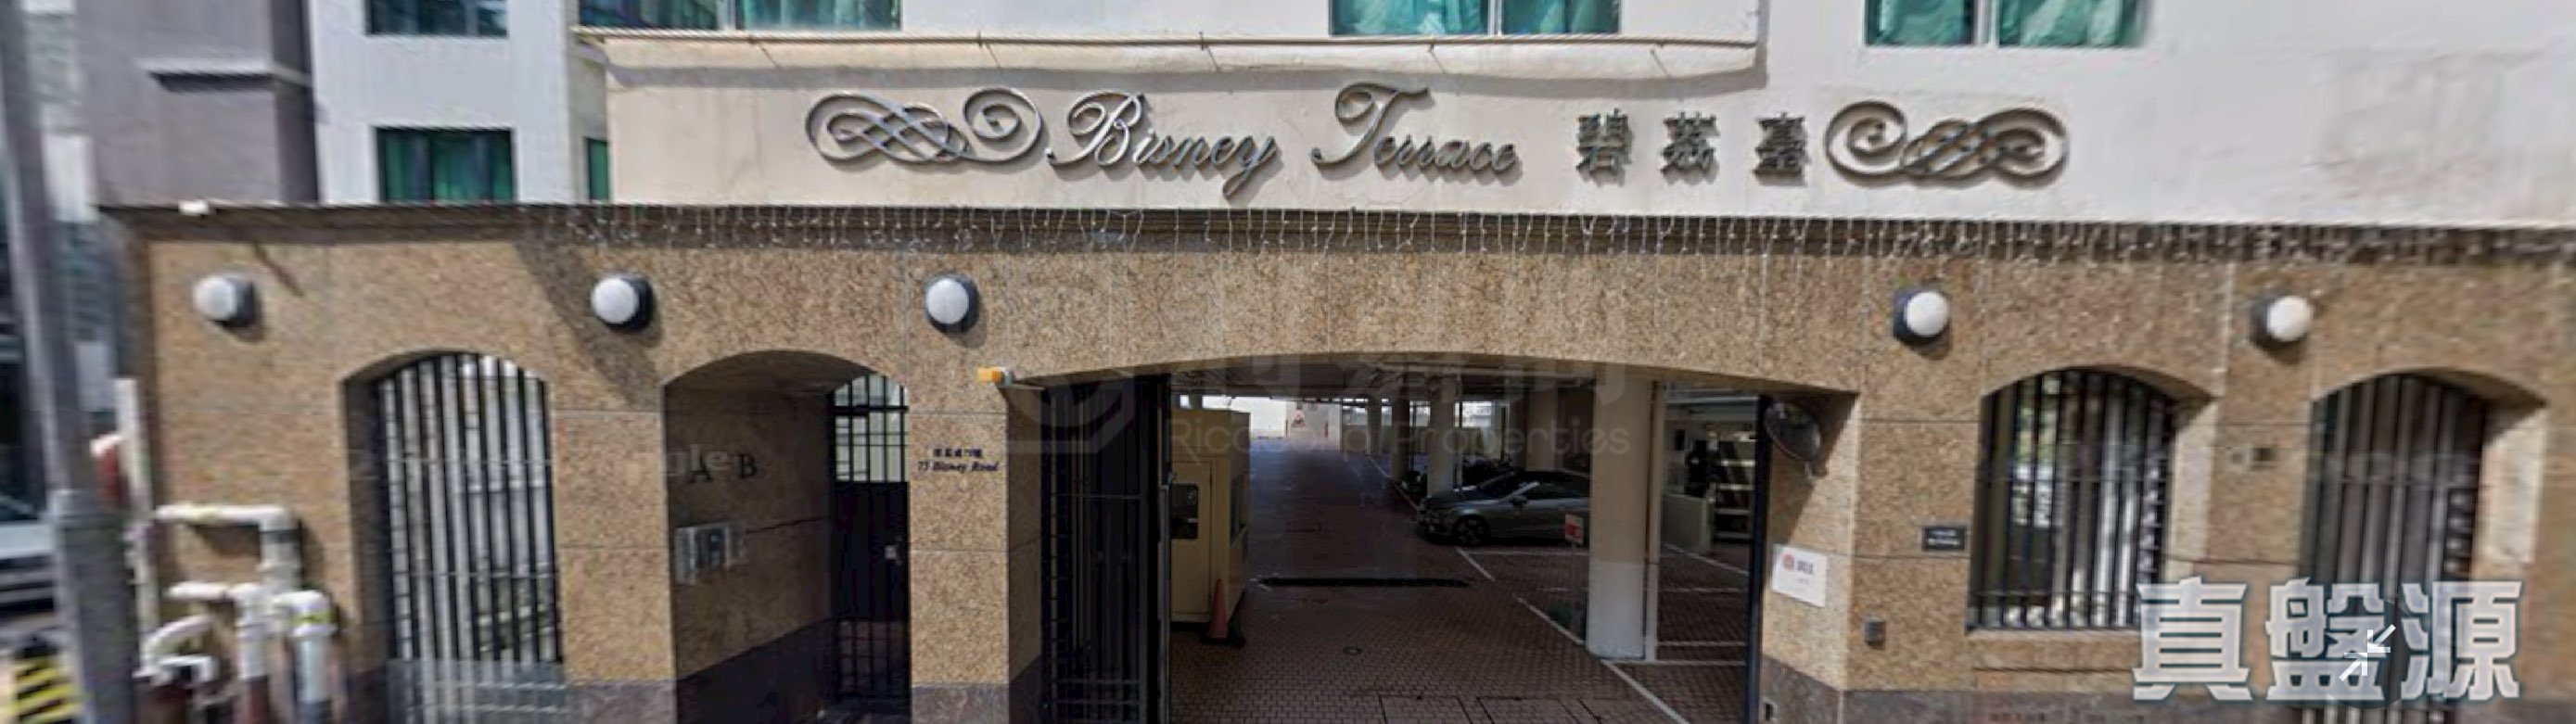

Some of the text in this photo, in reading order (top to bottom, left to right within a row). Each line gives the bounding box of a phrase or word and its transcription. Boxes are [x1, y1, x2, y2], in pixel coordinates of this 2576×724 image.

[1045, 82, 1517, 199] Bisney Terrace
[739, 452, 758, 478] B
